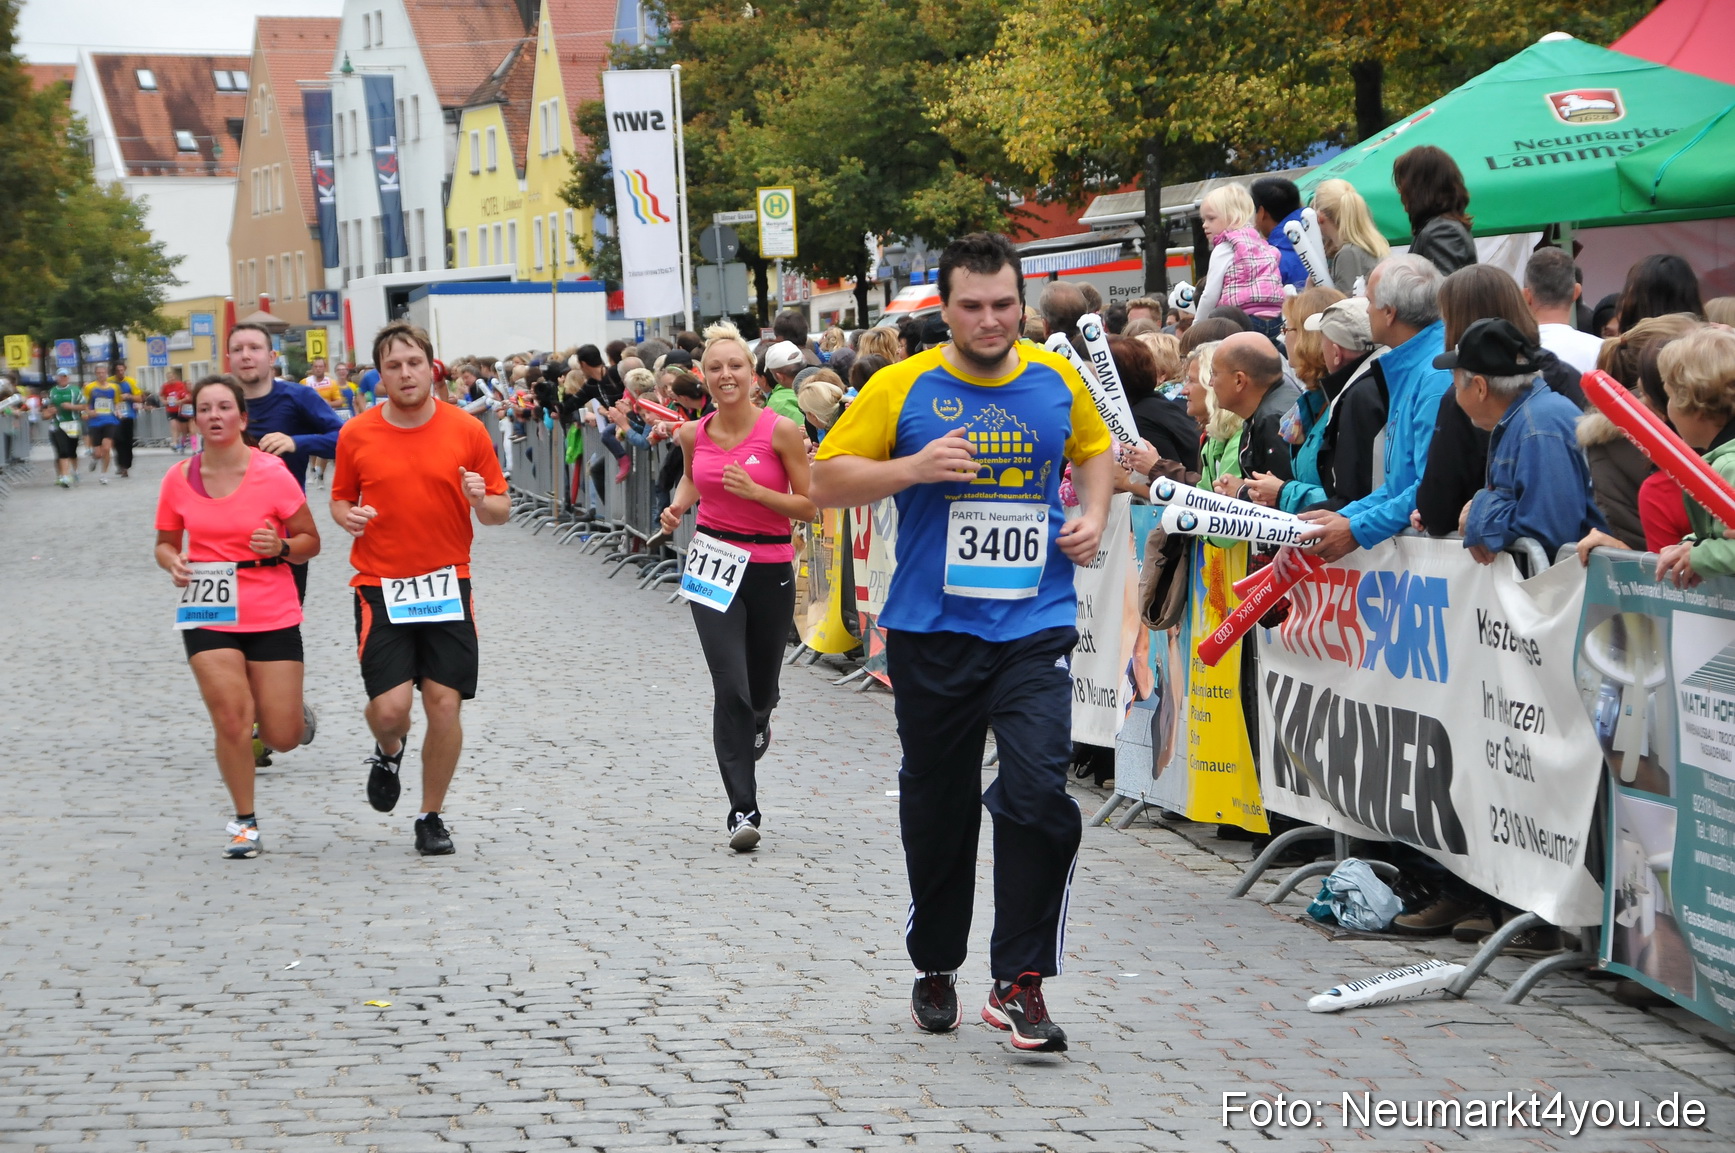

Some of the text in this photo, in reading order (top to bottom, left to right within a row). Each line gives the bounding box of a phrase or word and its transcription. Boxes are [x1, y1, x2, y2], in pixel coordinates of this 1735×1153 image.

[1513, 127, 1684, 151] Neumarkte
[1484, 140, 1650, 171] Lamms
[951, 511, 1034, 521] PARTL Neumarkt
[1207, 516, 1254, 538] BMW
[706, 543, 736, 560] Neumarkt
[958, 525, 1040, 562] 3406
[688, 548, 738, 587] 2114
[181, 578, 230, 604] 2726
[391, 573, 450, 603] 2117
[686, 580, 713, 597] Andrea
[1235, 581, 1273, 623] Audi BKK
[407, 604, 443, 616] Markus
[1504, 736, 1536, 783] Stadt
[1524, 815, 1581, 870] Neumar
